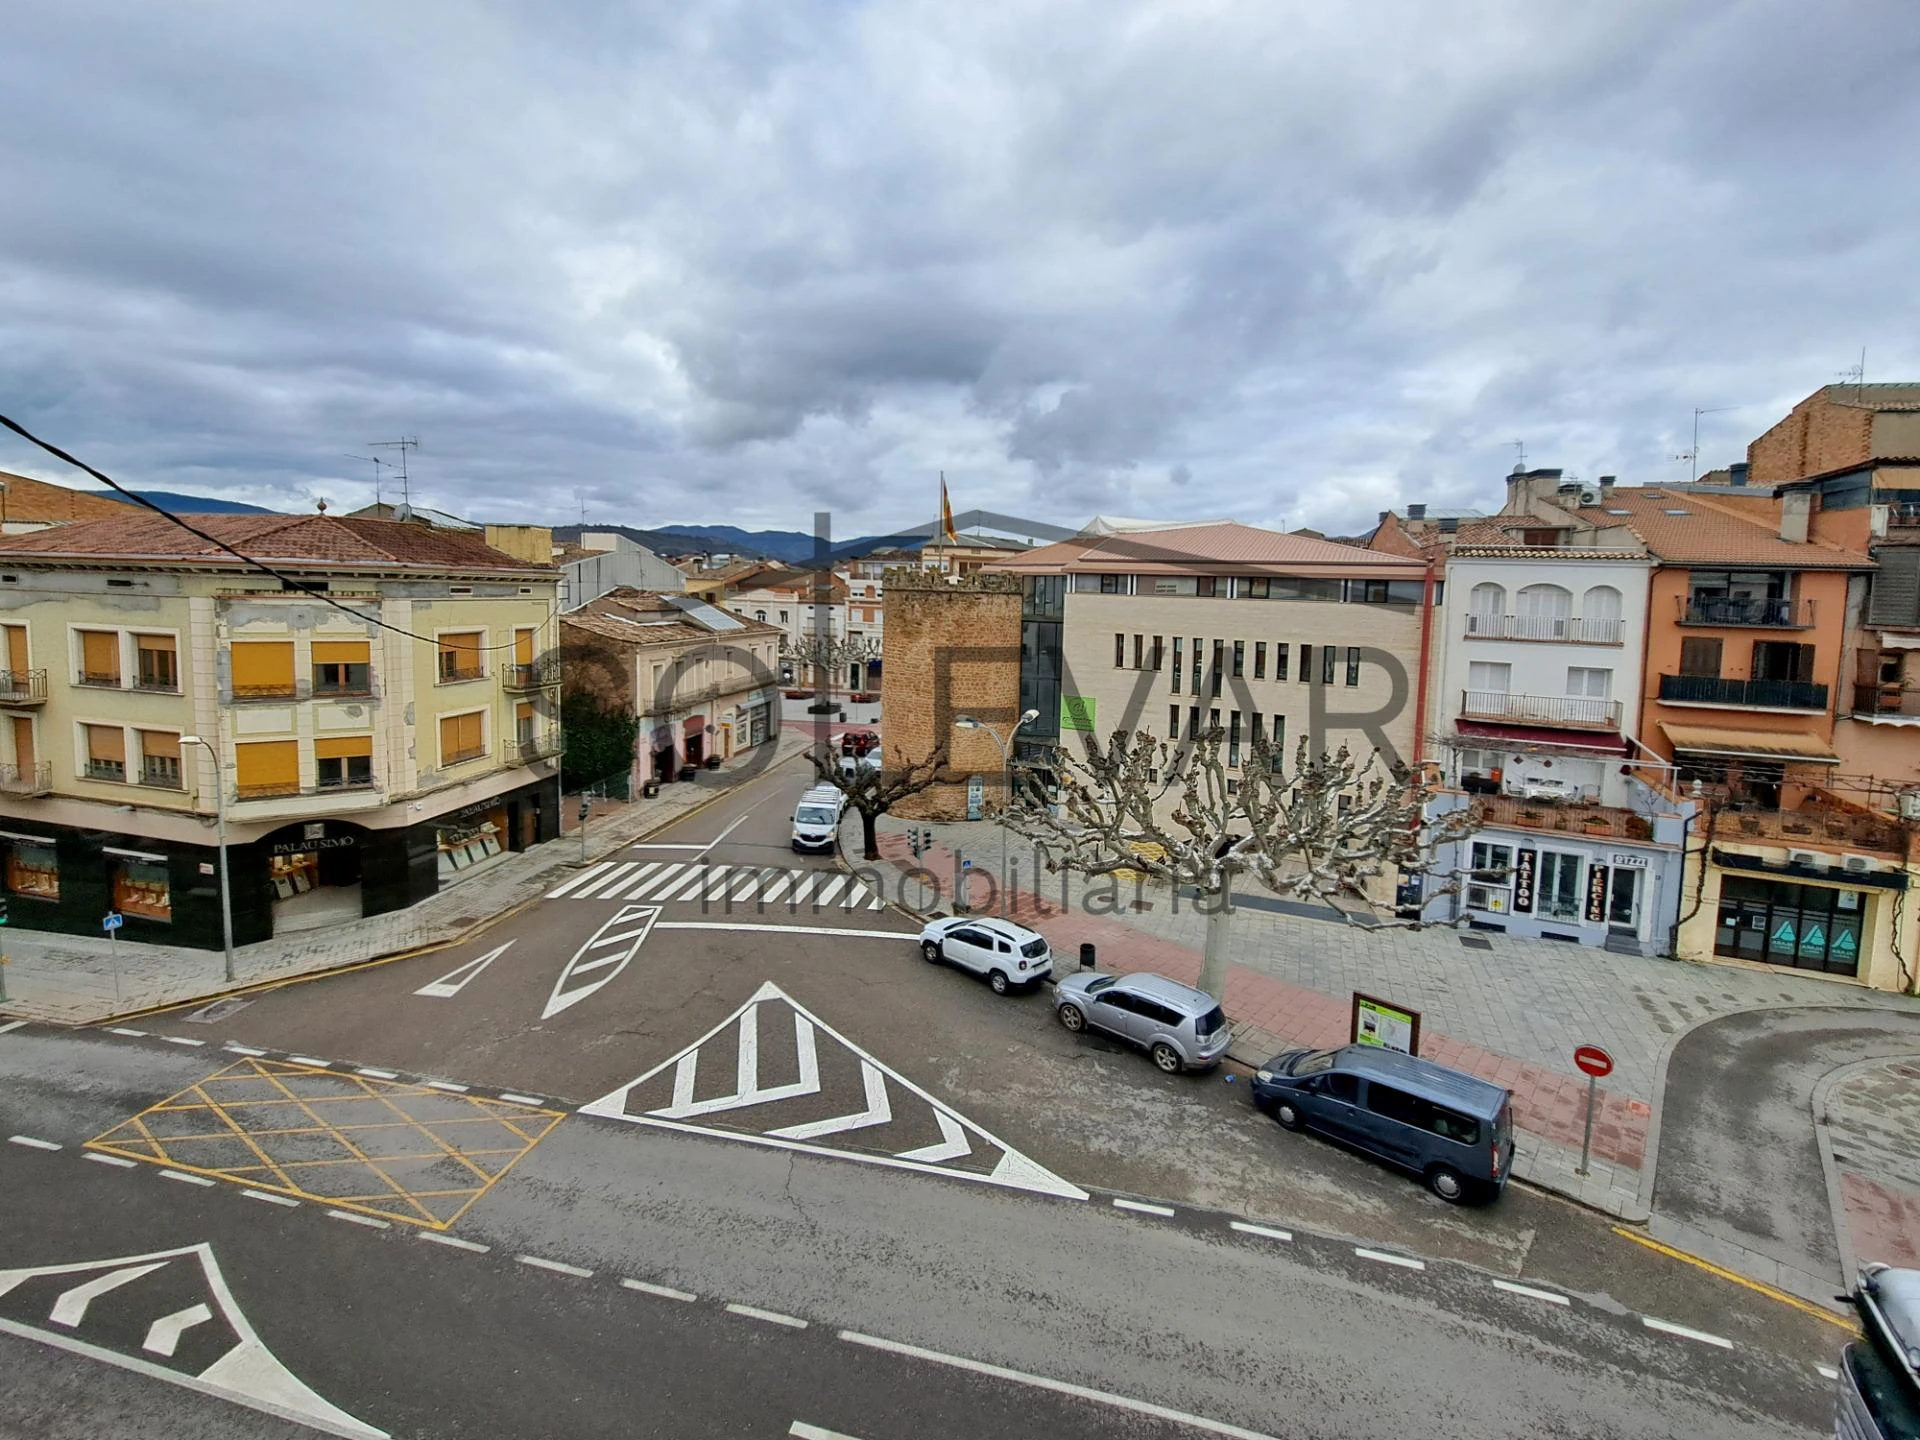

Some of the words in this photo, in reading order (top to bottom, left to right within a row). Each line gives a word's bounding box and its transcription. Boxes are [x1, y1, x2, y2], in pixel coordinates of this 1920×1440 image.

[274, 840, 318, 853] PALAU
[1517, 852, 1533, 906] TATTOO
[1589, 865, 1605, 921] PIERCING
